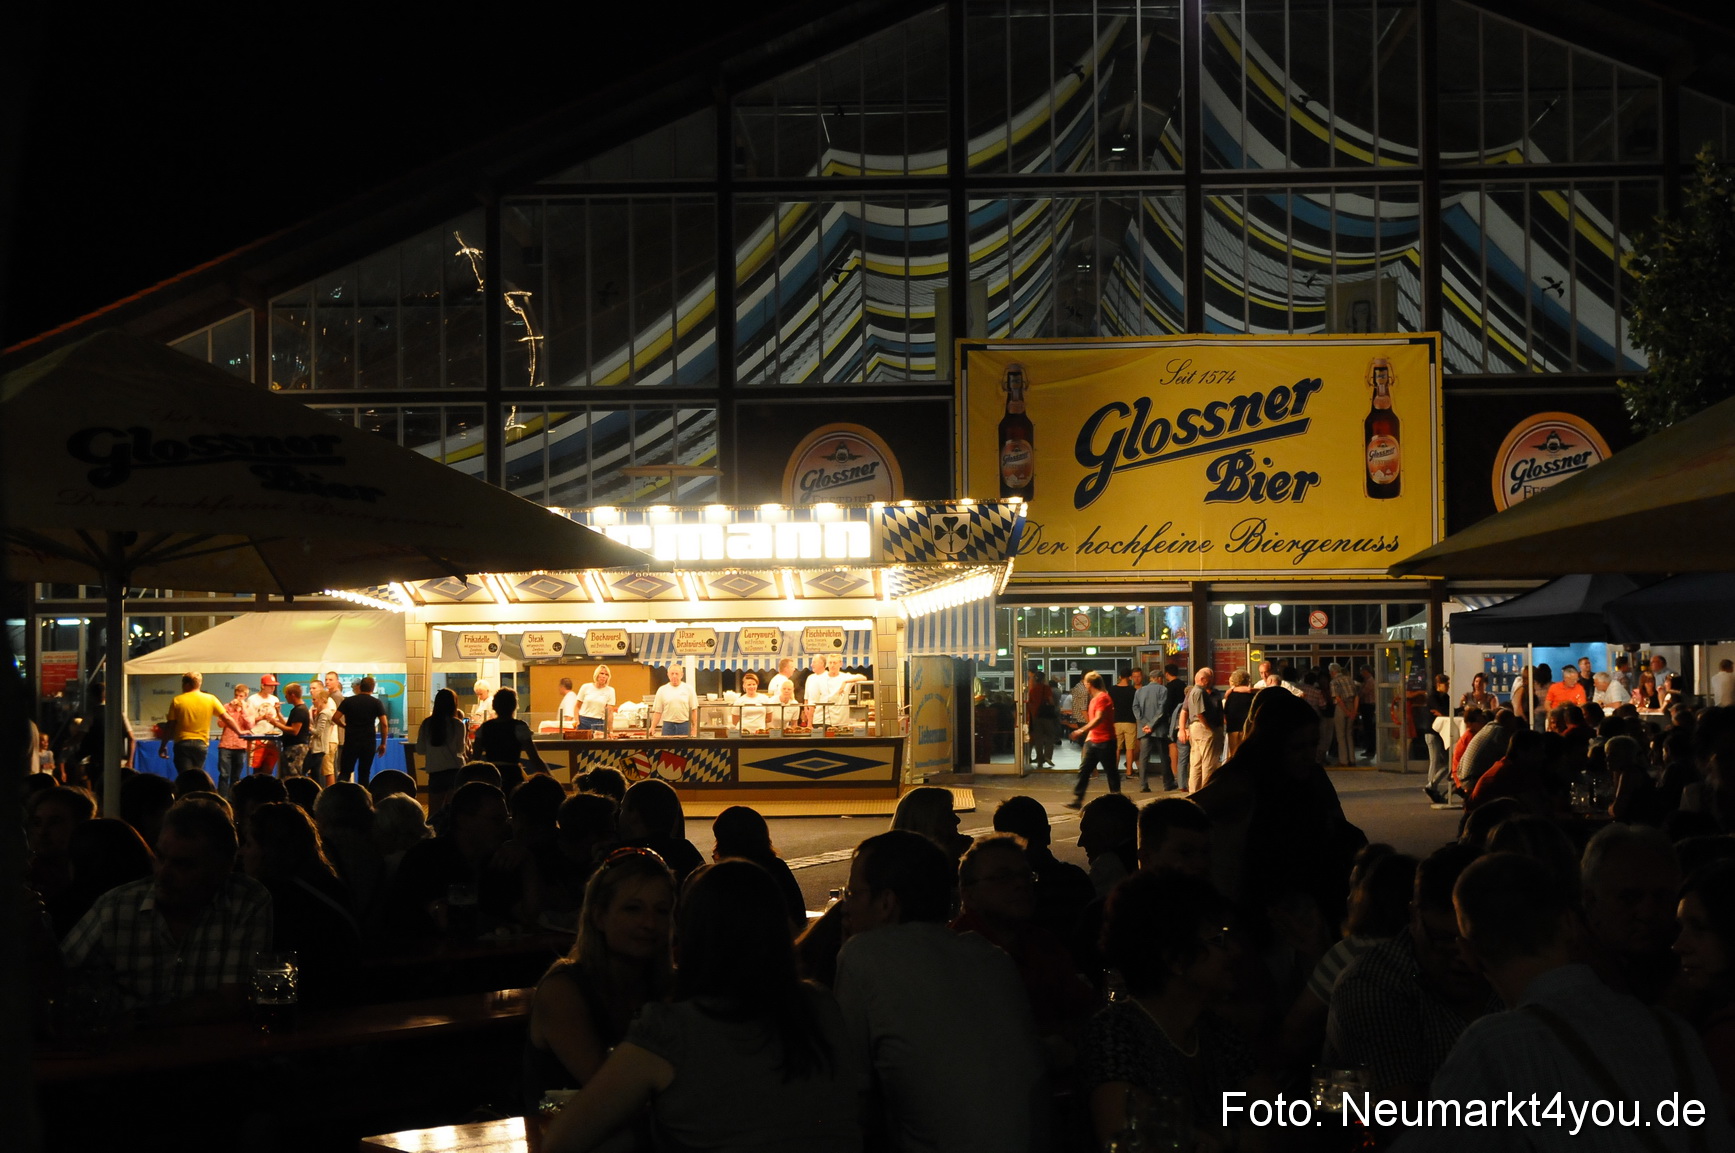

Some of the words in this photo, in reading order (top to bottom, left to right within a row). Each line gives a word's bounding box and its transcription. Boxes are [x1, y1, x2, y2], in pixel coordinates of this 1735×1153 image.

[1160, 359, 1193, 385] Seit
[1198, 370, 1236, 386] 1574
[66, 426, 345, 489] Glossner
[1074, 374, 1324, 510] Glossner
[251, 464, 385, 503] Bier
[800, 461, 880, 504] Glossner
[1203, 448, 1321, 504] Bier
[1510, 451, 1592, 495] Glossner
[1016, 520, 1068, 557] Der
[1075, 521, 1213, 567] hochfeine
[1224, 517, 1400, 564] Biergenuss
[464, 634, 490, 643] Frikadelle
[528, 634, 544, 643] Steak
[591, 632, 622, 642] Bockwurst
[744, 629, 775, 639] Currywurst
[806, 629, 841, 638] Fischbrötchen
